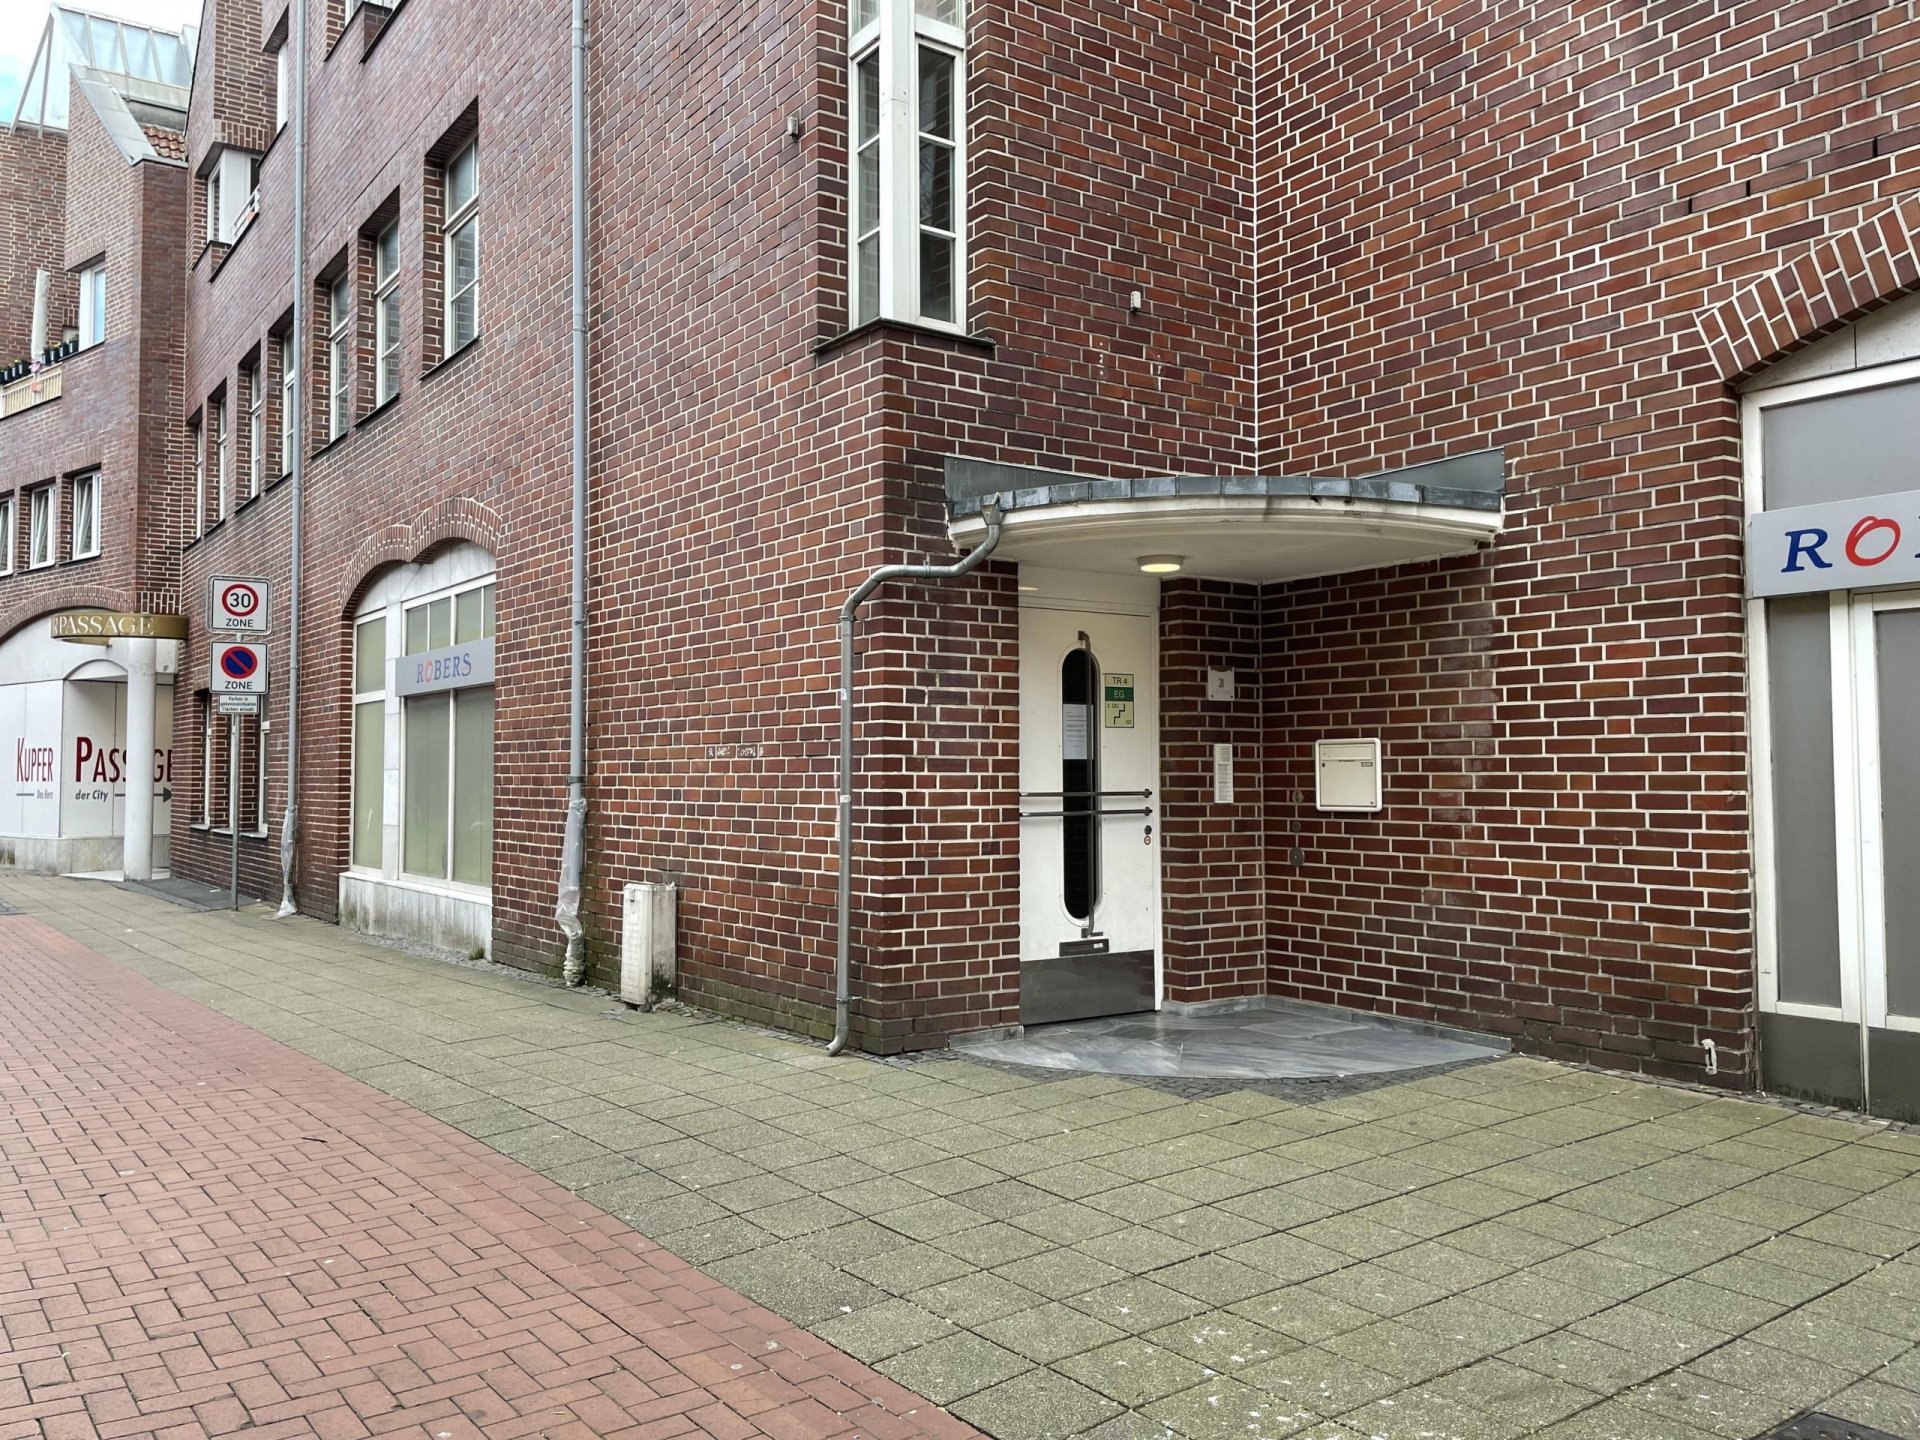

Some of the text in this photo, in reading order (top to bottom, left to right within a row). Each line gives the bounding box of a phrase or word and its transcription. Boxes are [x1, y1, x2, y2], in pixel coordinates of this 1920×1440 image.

[1780, 515, 1920, 573] RO
[230, 592, 251, 608] 30
[225, 618, 254, 628] ZONE
[416, 652, 472, 683] ROBERS
[224, 680, 253, 690] ZONE
[1112, 676, 1128, 685] TR 4
[1113, 689, 1125, 698] EG
[16, 737, 53, 782] KUPFER
[75, 789, 91, 800] der
[92, 789, 109, 802] City
